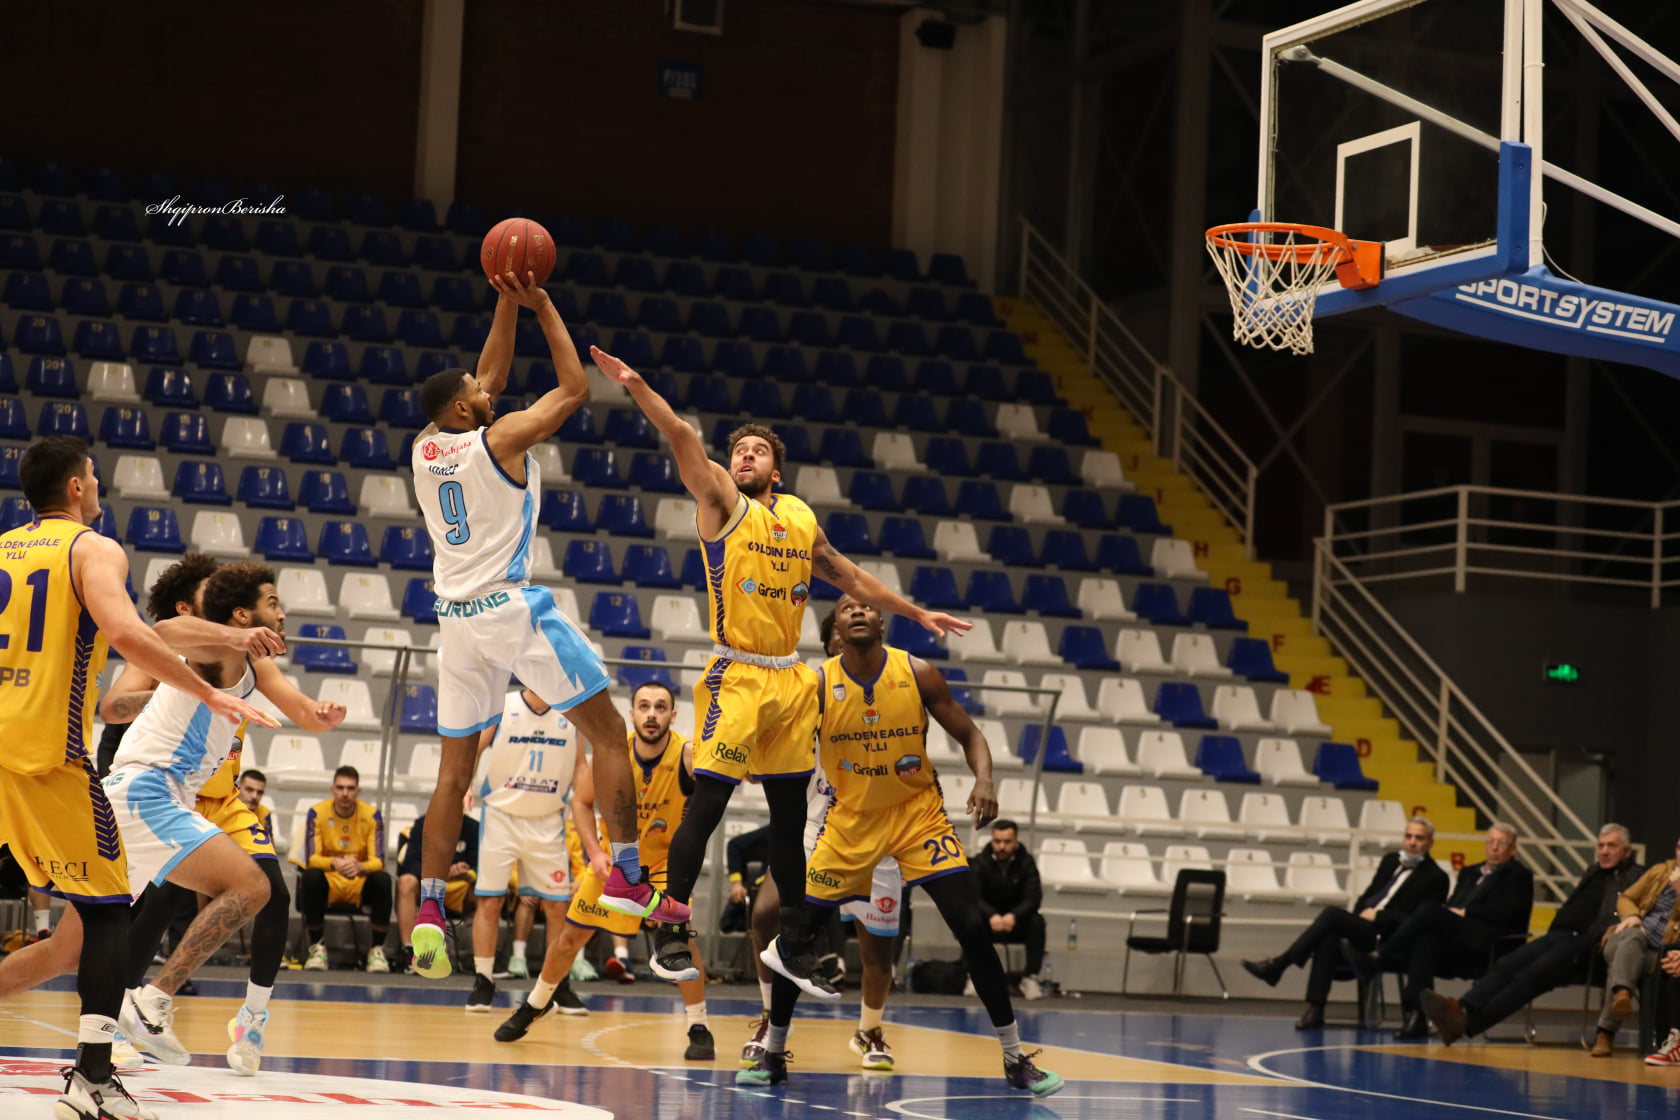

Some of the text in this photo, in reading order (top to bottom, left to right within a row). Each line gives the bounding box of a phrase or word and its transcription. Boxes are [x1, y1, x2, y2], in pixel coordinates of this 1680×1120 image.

[32, 317, 46, 328] 20
[46, 360, 59, 370] 20
[57, 403, 72, 414] 20
[119, 409, 132, 420] 19
[5, 449, 19, 459] 21
[258, 469, 270, 479] 17
[18, 499, 31, 509] 21
[147, 510, 160, 521] 19
[438, 480, 470, 545] 9
[276, 520, 289, 530] 17
[339, 524, 352, 535] 16
[400, 528, 413, 539] 15
[26, 538, 61, 549] EAGLE
[1194, 540, 1208, 557] H
[6, 550, 27, 560] YLLI
[1226, 577, 1241, 595] G
[609, 596, 622, 606] 12
[670, 600, 680, 608] 11
[316, 627, 329, 638] 17
[1272, 634, 1285, 652] F
[640, 649, 651, 660] 12
[338, 682, 352, 692] 17
[1319, 675, 1332, 695] E
[830, 726, 920, 744] GOLDEN EAGLE
[363, 743, 376, 753] 17
[715, 741, 748, 764] Relax
[863, 742, 888, 752] YLLI
[1355, 738, 1372, 758] D
[529, 750, 543, 773] 11
[731, 824, 743, 834] 12
[923, 835, 960, 867] 20
[1451, 852, 1465, 870] B
[807, 866, 841, 889] Relax
[577, 898, 610, 919] Relax
